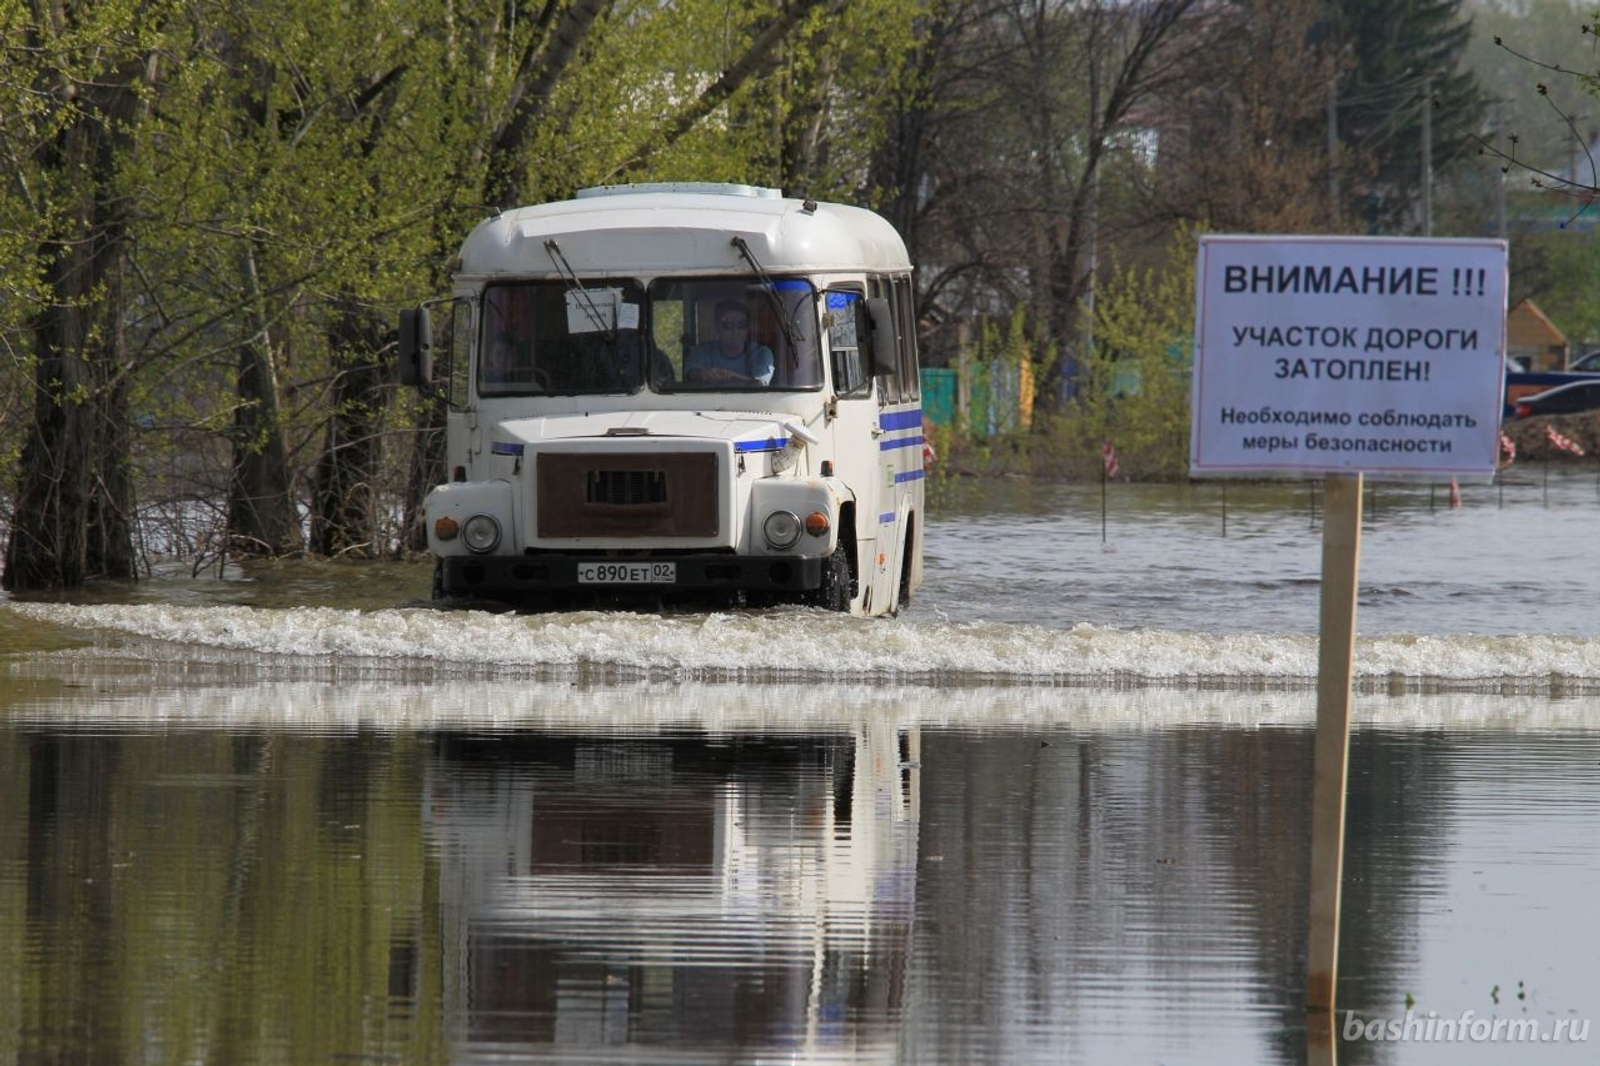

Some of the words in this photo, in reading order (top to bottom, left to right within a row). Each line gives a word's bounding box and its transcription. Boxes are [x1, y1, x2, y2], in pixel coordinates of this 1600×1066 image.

[1223, 265, 1439, 295] ВНИМАНИЕ
[1452, 267, 1486, 296] !!!
[1232, 326, 1358, 348] УЧАСТОК
[1364, 328, 1478, 351] ДОРОГИ
[1274, 358, 1431, 382] ЗАТОПЛЕН!
[1220, 407, 1351, 426] Необходимо
[1358, 409, 1477, 429] соблюдать
[1242, 435, 1298, 453] меры
[1304, 433, 1452, 453] безопасности
[653, 564, 671, 577] 02
